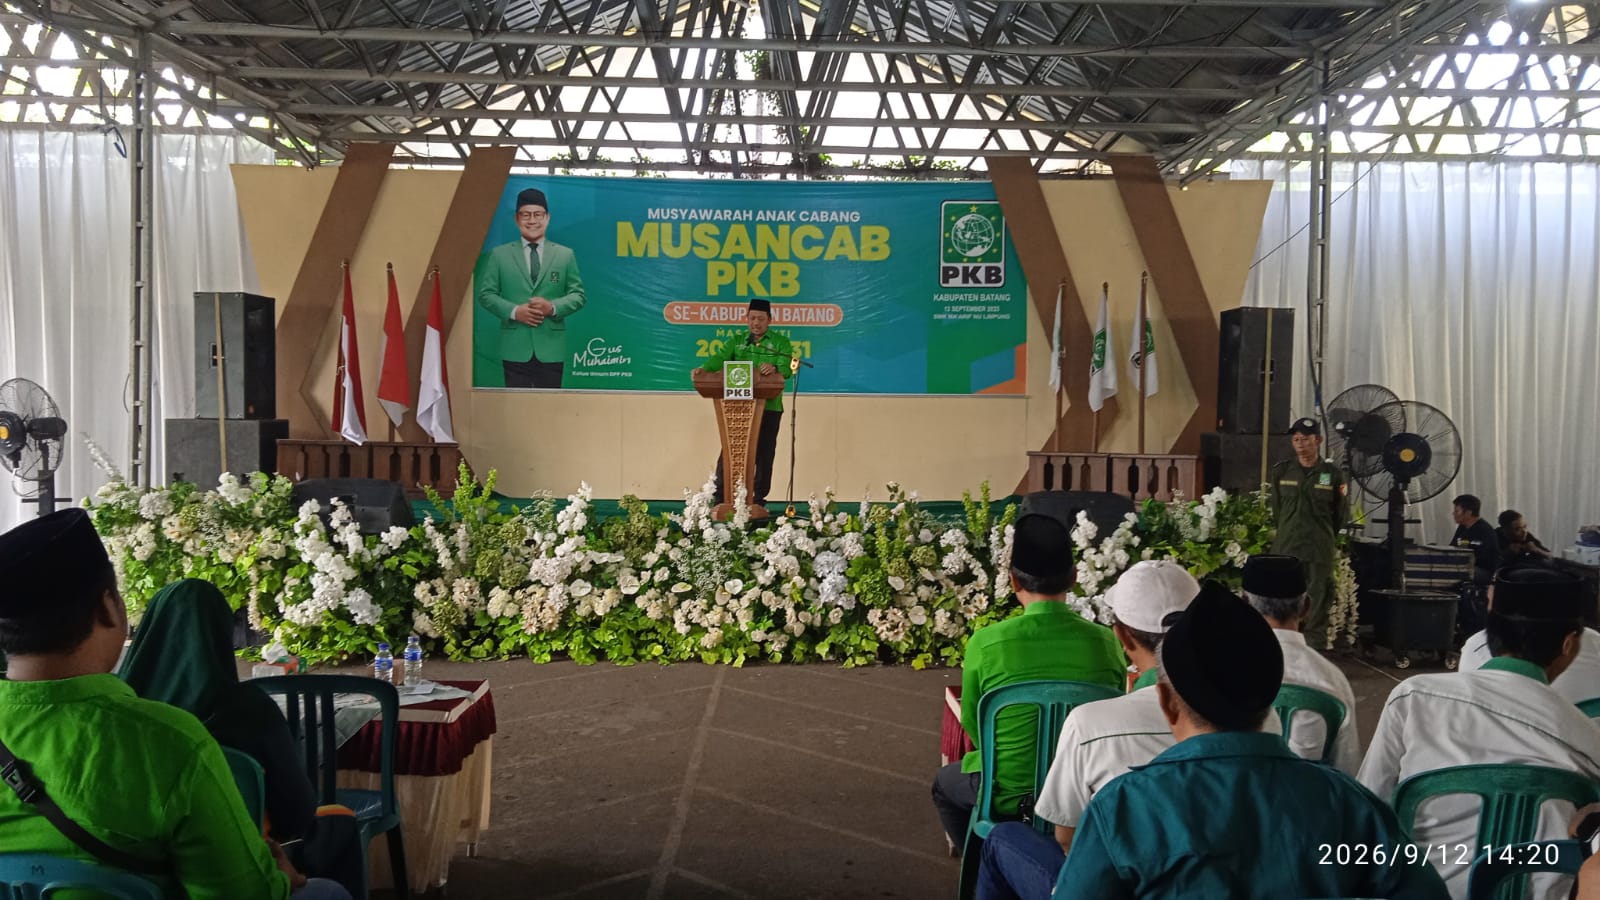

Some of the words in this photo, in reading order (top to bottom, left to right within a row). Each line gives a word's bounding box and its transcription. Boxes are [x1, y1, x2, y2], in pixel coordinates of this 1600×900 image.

[647, 208, 753, 221] MUSYAWARAH
[755, 209, 796, 222] ANAK
[799, 210, 861, 223] CABANG
[616, 221, 890, 261] MUSANCAB
[706, 260, 800, 297] PKB
[942, 265, 1002, 284] PKB
[933, 293, 978, 302] KABUPATEN
[979, 293, 1011, 302] BATANG
[673, 305, 779, 321] SE-KABUPN
[782, 307, 835, 323] BATANG
[587, 337, 623, 357] Gus
[726, 389, 751, 397] PKB
